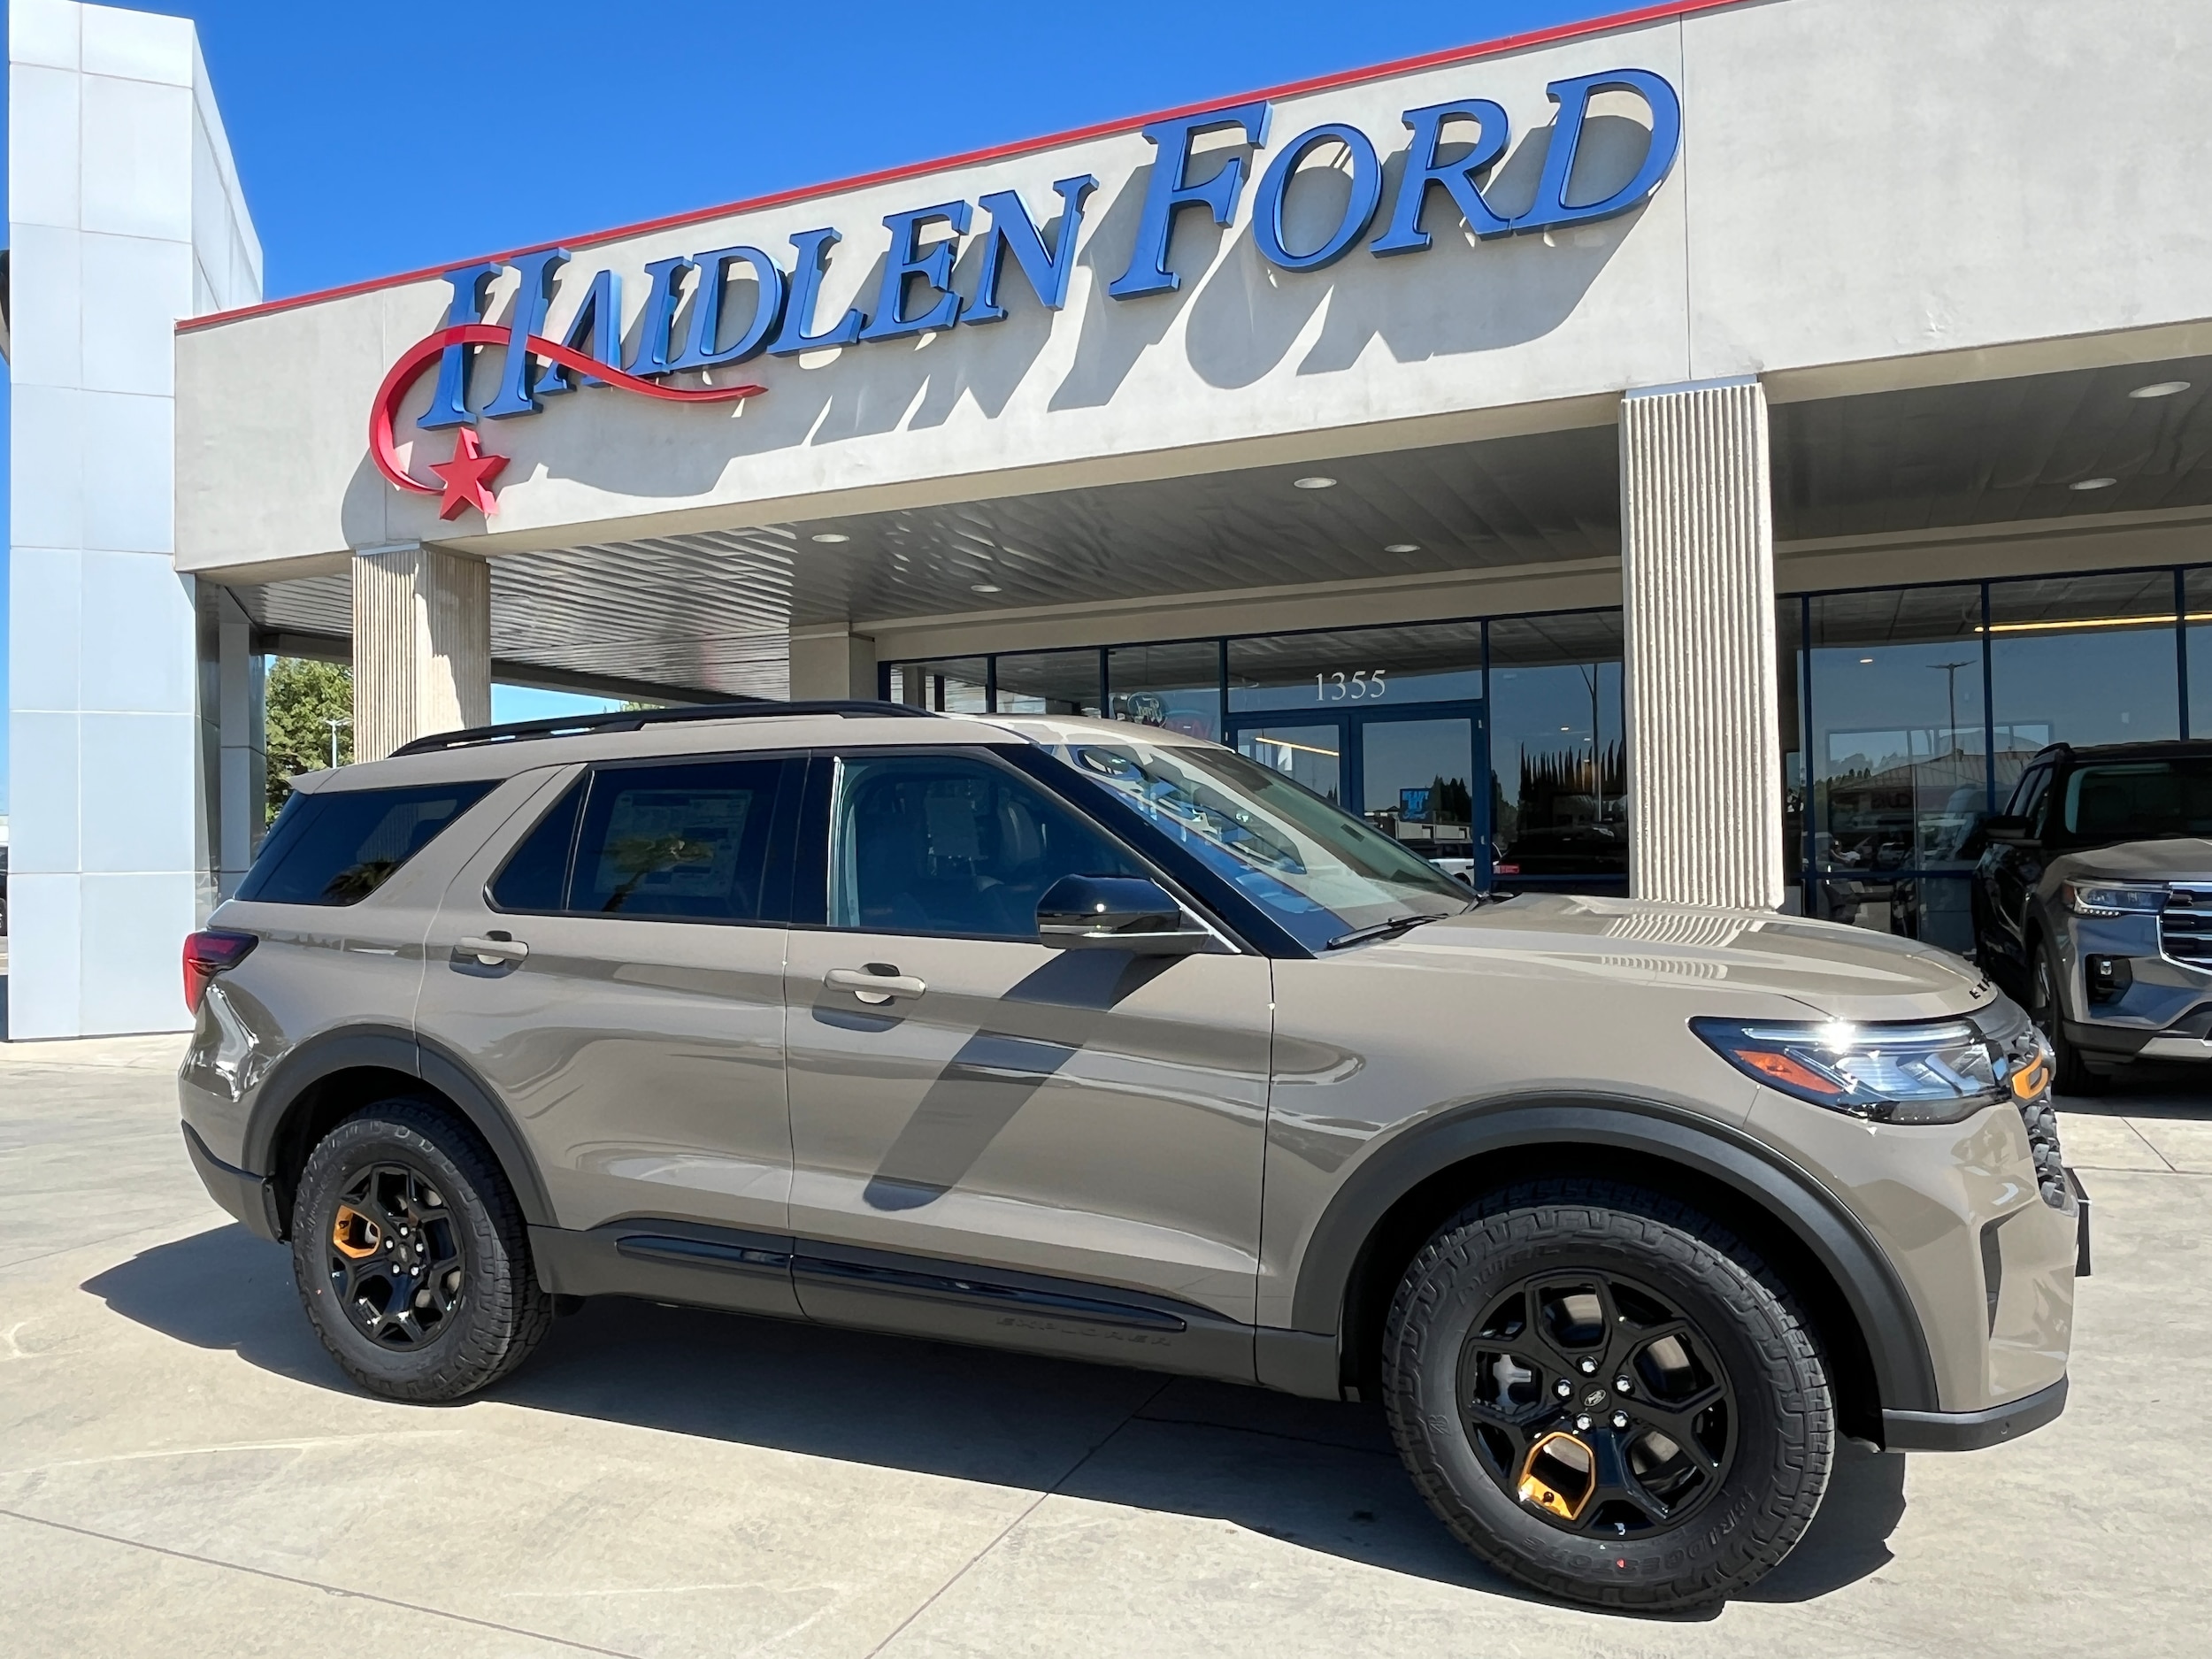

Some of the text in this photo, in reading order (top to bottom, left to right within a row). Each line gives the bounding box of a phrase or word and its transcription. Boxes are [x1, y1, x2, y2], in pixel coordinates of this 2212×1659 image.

[416, 68, 1682, 430] HAIDLEN FORD
[1315, 669, 1386, 702] 1355
